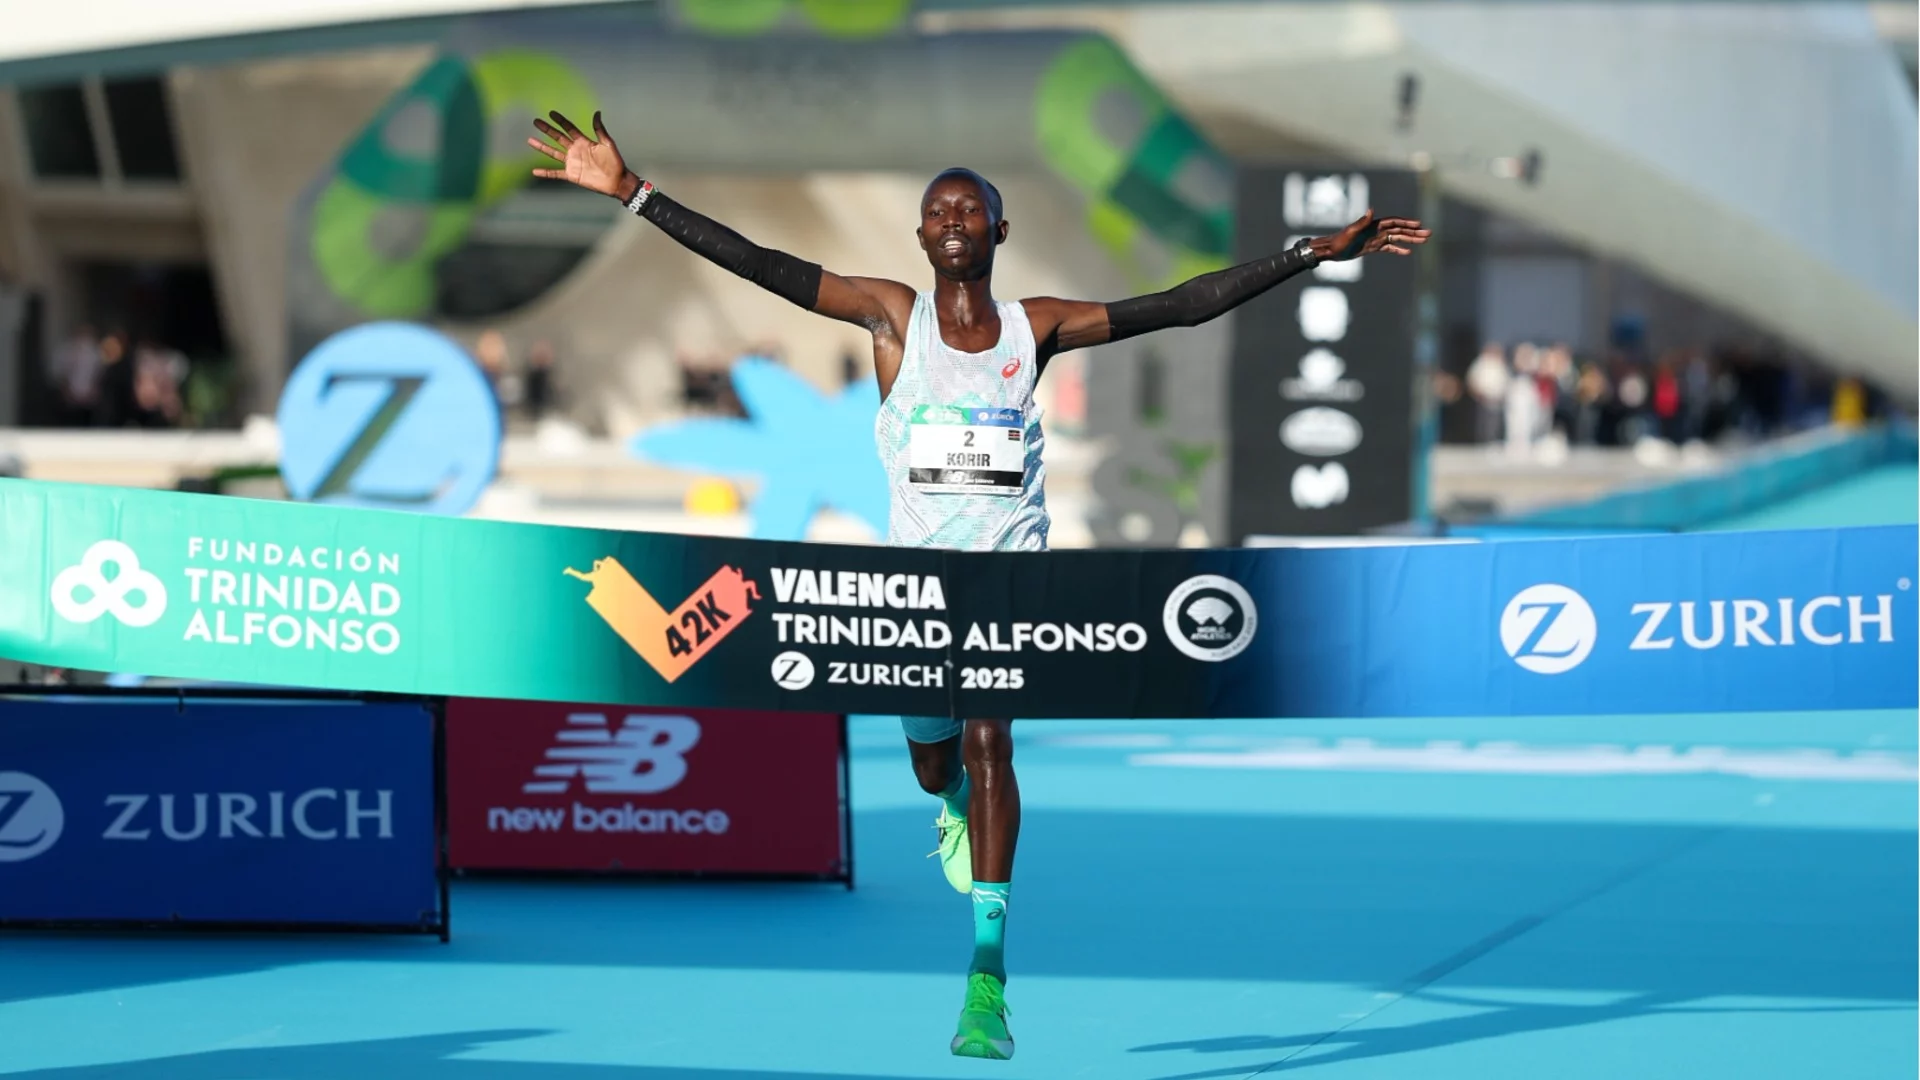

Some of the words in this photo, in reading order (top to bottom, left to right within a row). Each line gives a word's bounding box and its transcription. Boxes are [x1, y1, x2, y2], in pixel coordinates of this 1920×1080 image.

[963, 430, 975, 448] 2
[947, 453, 991, 467] KORIR
[187, 536, 400, 575] FUNDACIÓN
[184, 567, 401, 617] TRINIDAD
[770, 567, 947, 610] VALENCIA
[184, 608, 401, 655] ALFONSO
[666, 590, 732, 660] 42K
[771, 613, 952, 649] TRINIDAD
[963, 622, 1147, 652] ALFONSO
[1629, 595, 1894, 650] ZURICH
[828, 662, 944, 687] ZURICH
[960, 667, 1024, 691] 2025
[101, 787, 394, 842] ZURICH
[488, 806, 565, 833] new
[573, 801, 730, 835] balance
